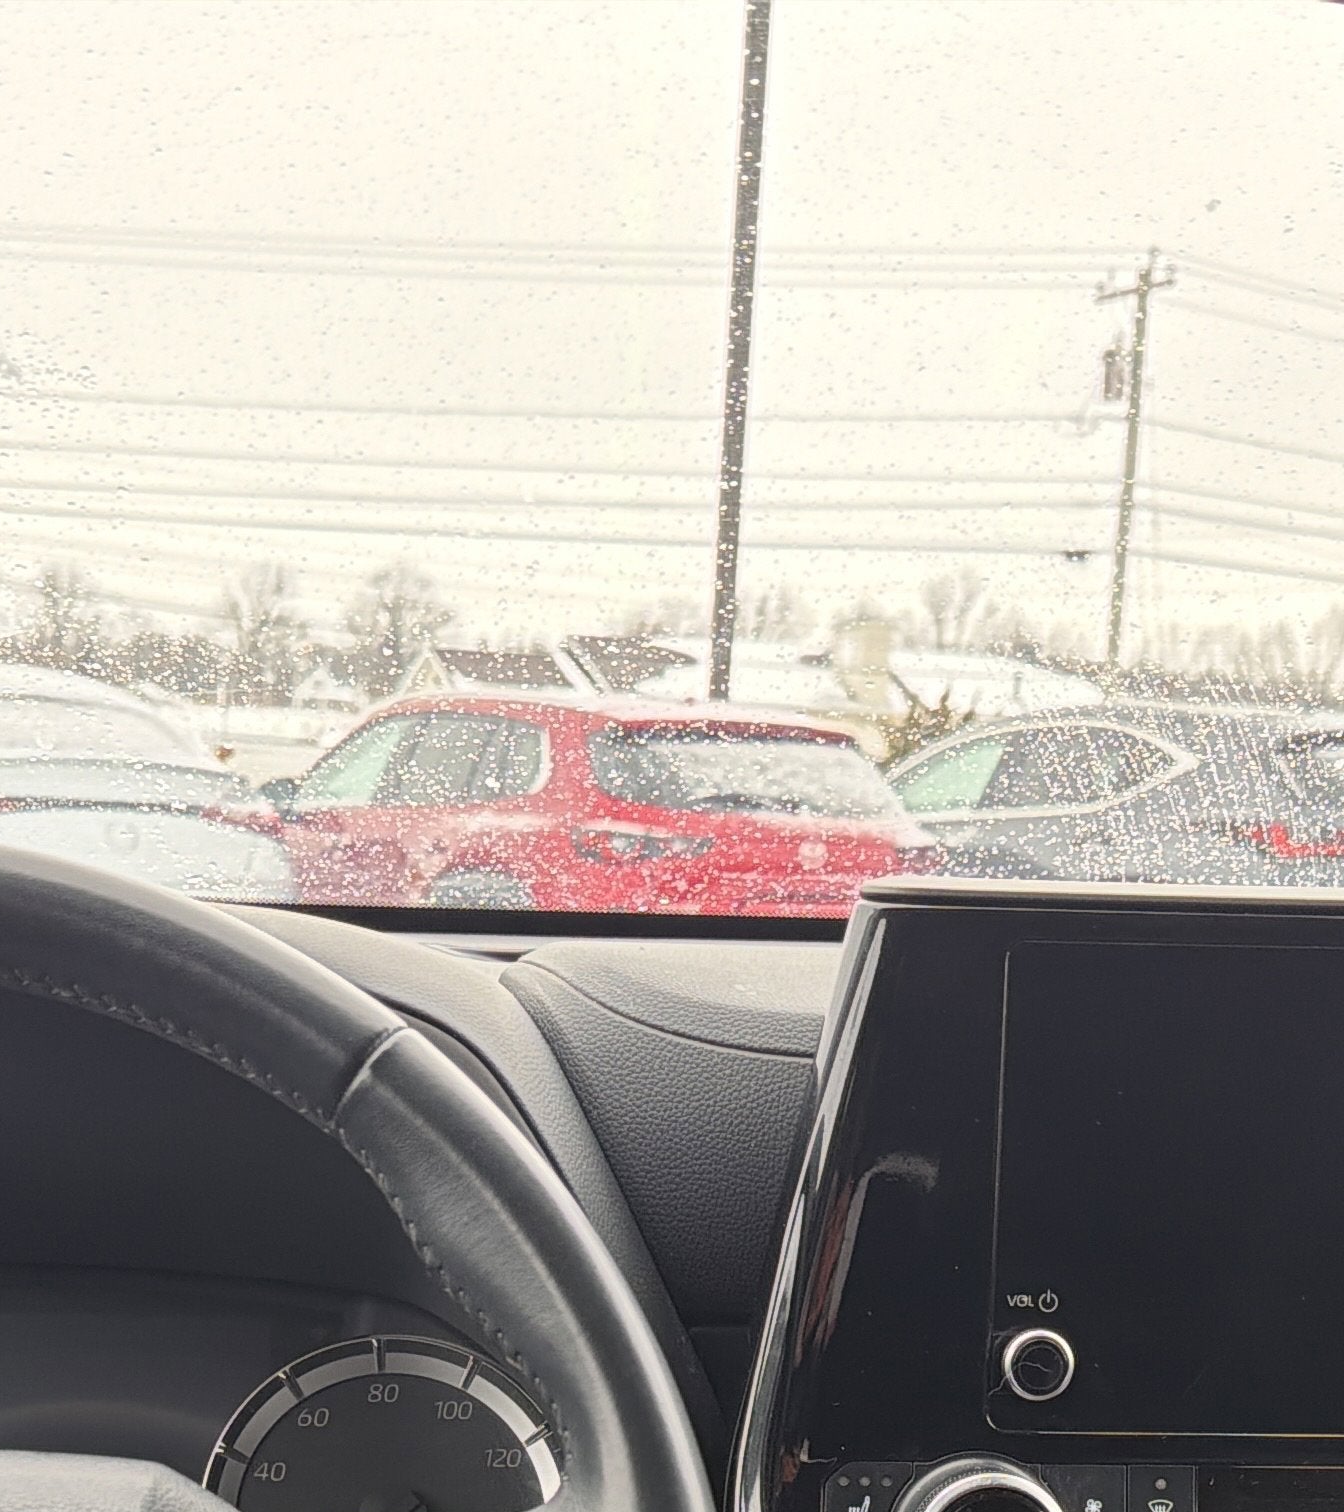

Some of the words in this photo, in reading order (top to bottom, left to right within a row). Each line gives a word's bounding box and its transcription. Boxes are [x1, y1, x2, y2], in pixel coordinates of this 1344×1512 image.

[1006, 1294, 1035, 1308] VOL
[367, 1383, 400, 1403] 80
[297, 1407, 330, 1428] 60
[434, 1400, 474, 1421] 100
[484, 1448, 522, 1468] 120
[253, 1461, 287, 1482] 40
